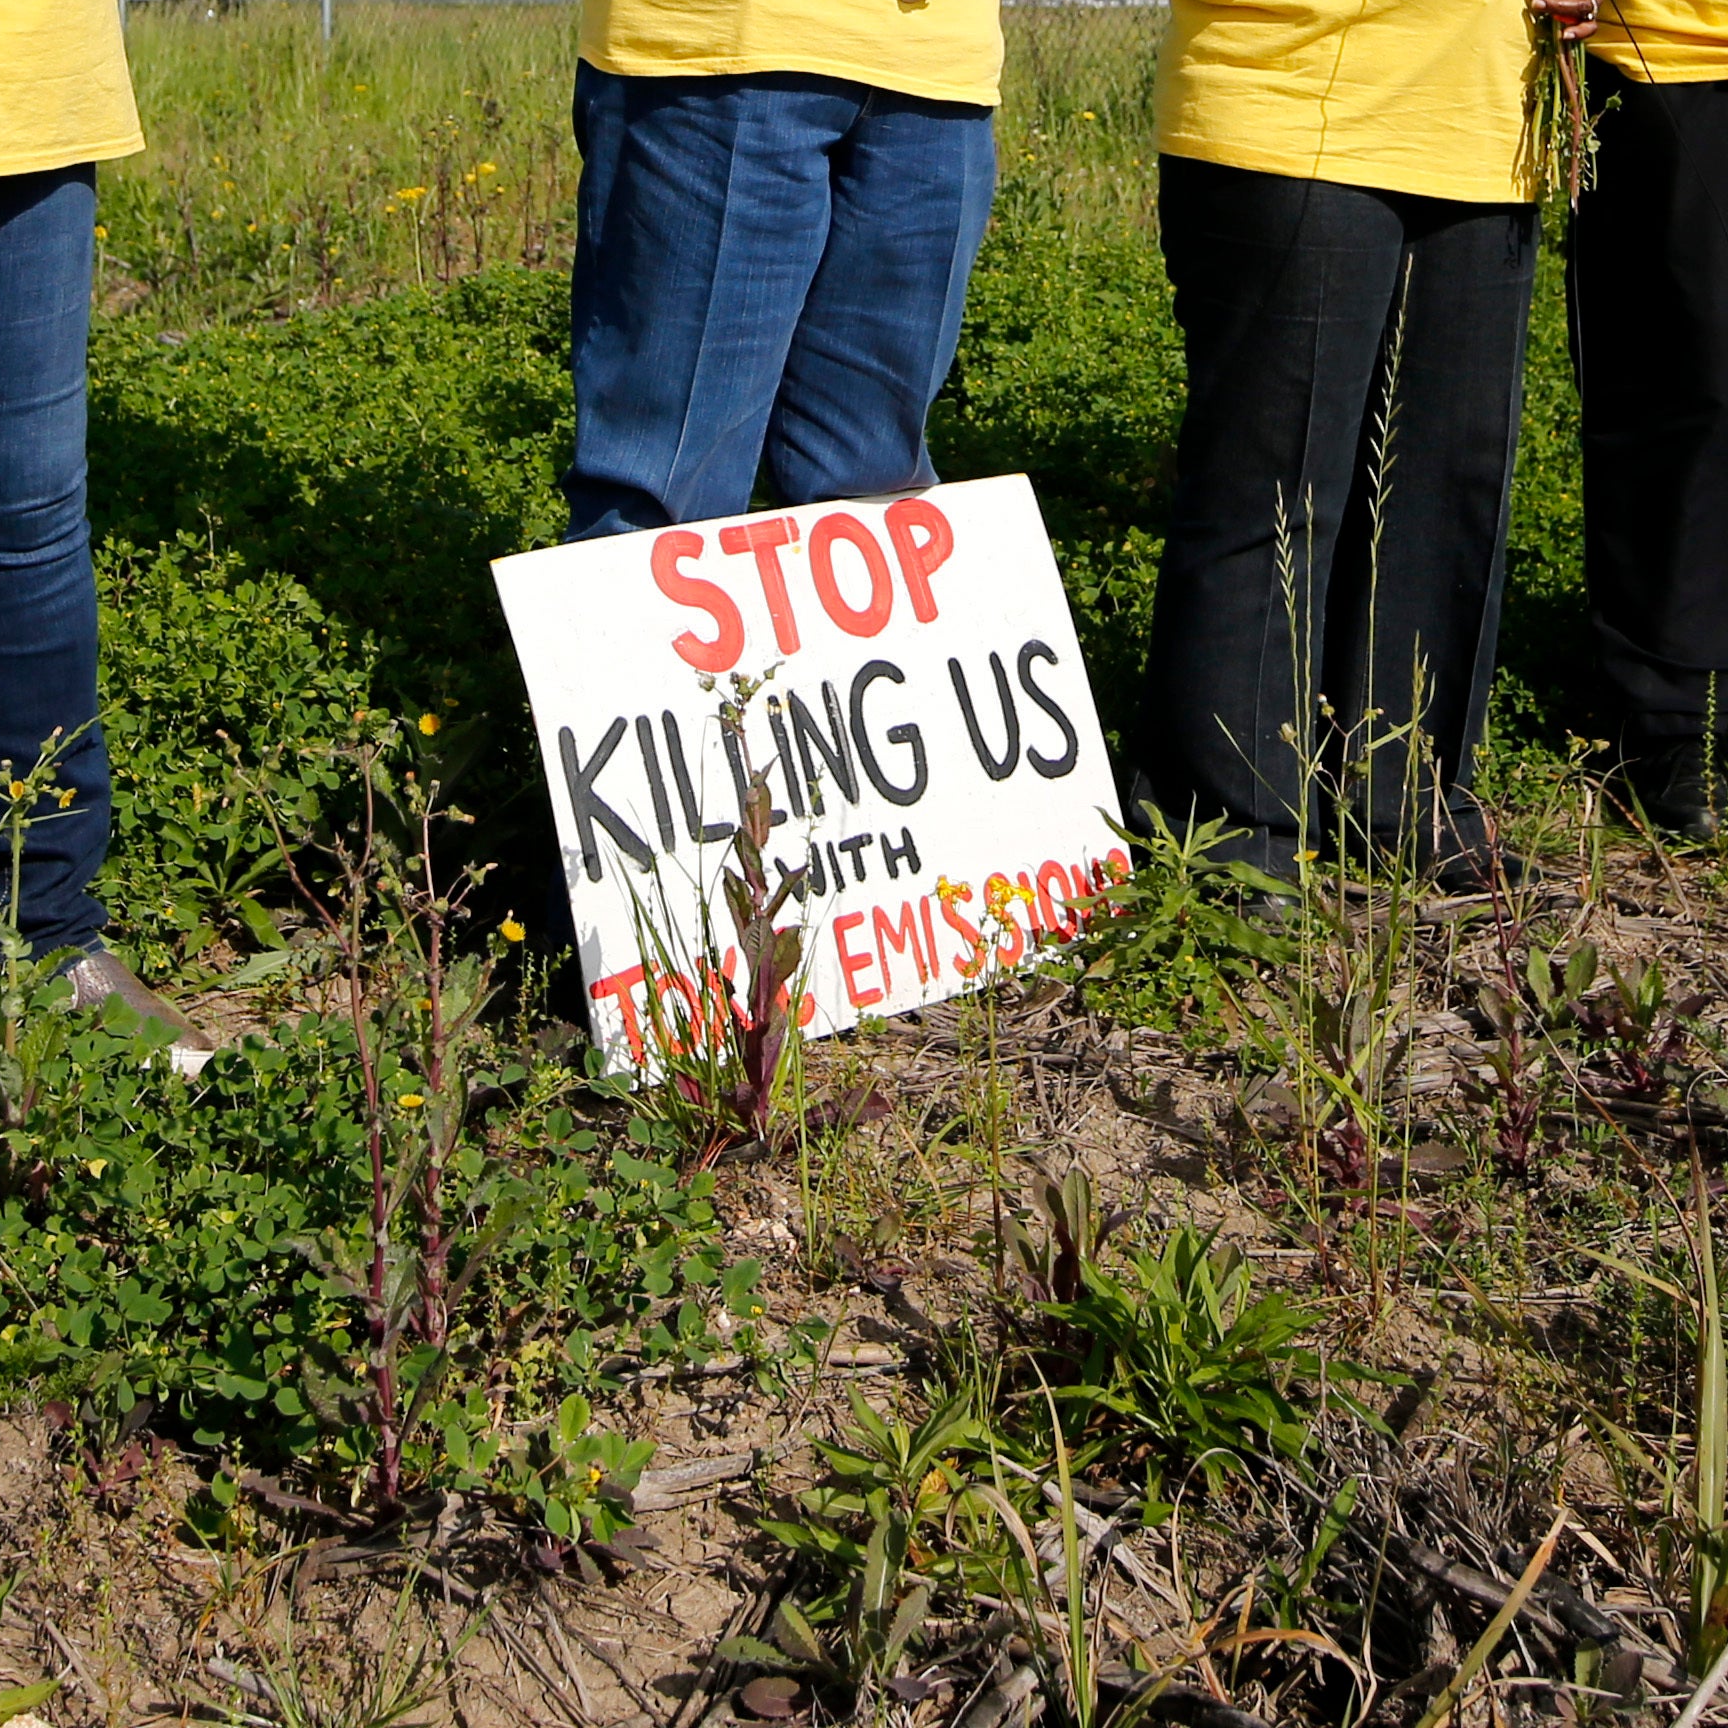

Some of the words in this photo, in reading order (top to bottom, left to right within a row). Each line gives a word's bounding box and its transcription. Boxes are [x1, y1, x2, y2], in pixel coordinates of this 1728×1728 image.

[650, 497, 954, 674] STOP
[557, 659, 929, 884] KILLING
[946, 639, 1079, 782] US
[773, 826, 922, 904] WITH
